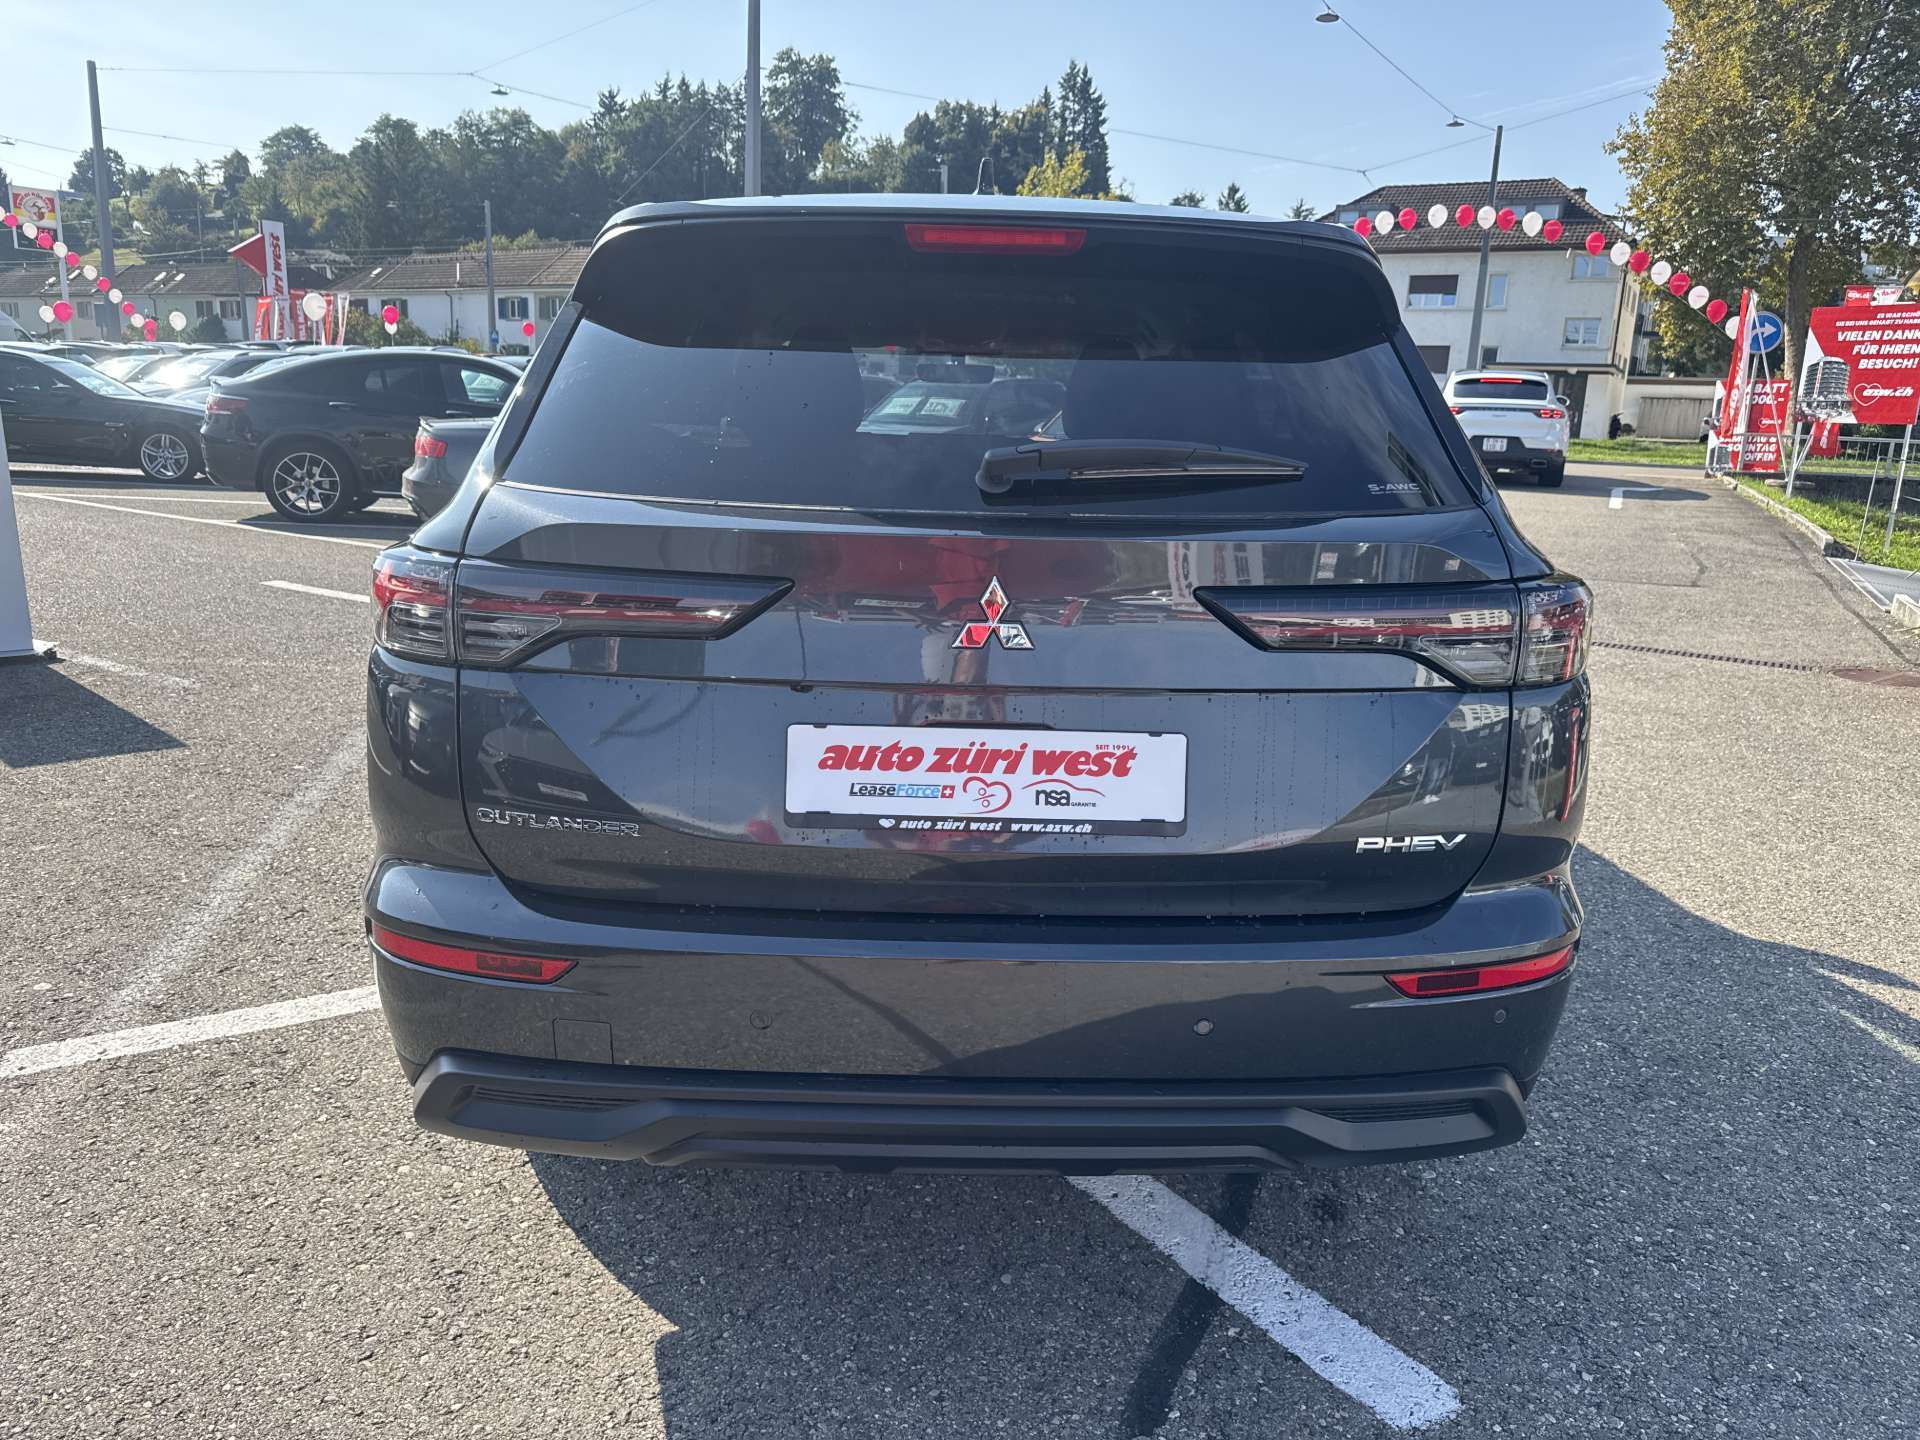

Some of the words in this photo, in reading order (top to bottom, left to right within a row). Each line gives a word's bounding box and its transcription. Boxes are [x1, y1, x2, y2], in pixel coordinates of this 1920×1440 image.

[1837, 330, 1882, 341] VIELEN
[1852, 342, 1879, 355] FÜR
[1880, 343, 1920, 355] IHREN
[1858, 357, 1919, 369] BESUCH!
[1367, 483, 1420, 491] S-AWC
[818, 739, 924, 772] auto
[925, 741, 1028, 775] züri
[1032, 746, 1138, 778] west
[849, 782, 941, 798] LeaseForce
[1035, 789, 1071, 807] nsa
[476, 807, 641, 837] OUTLANDER
[899, 819, 932, 830] auto
[934, 819, 966, 831] züri
[969, 821, 1003, 832] west
[1010, 822, 1093, 834] www.azw.ch
[1355, 833, 1467, 854] PHEV
